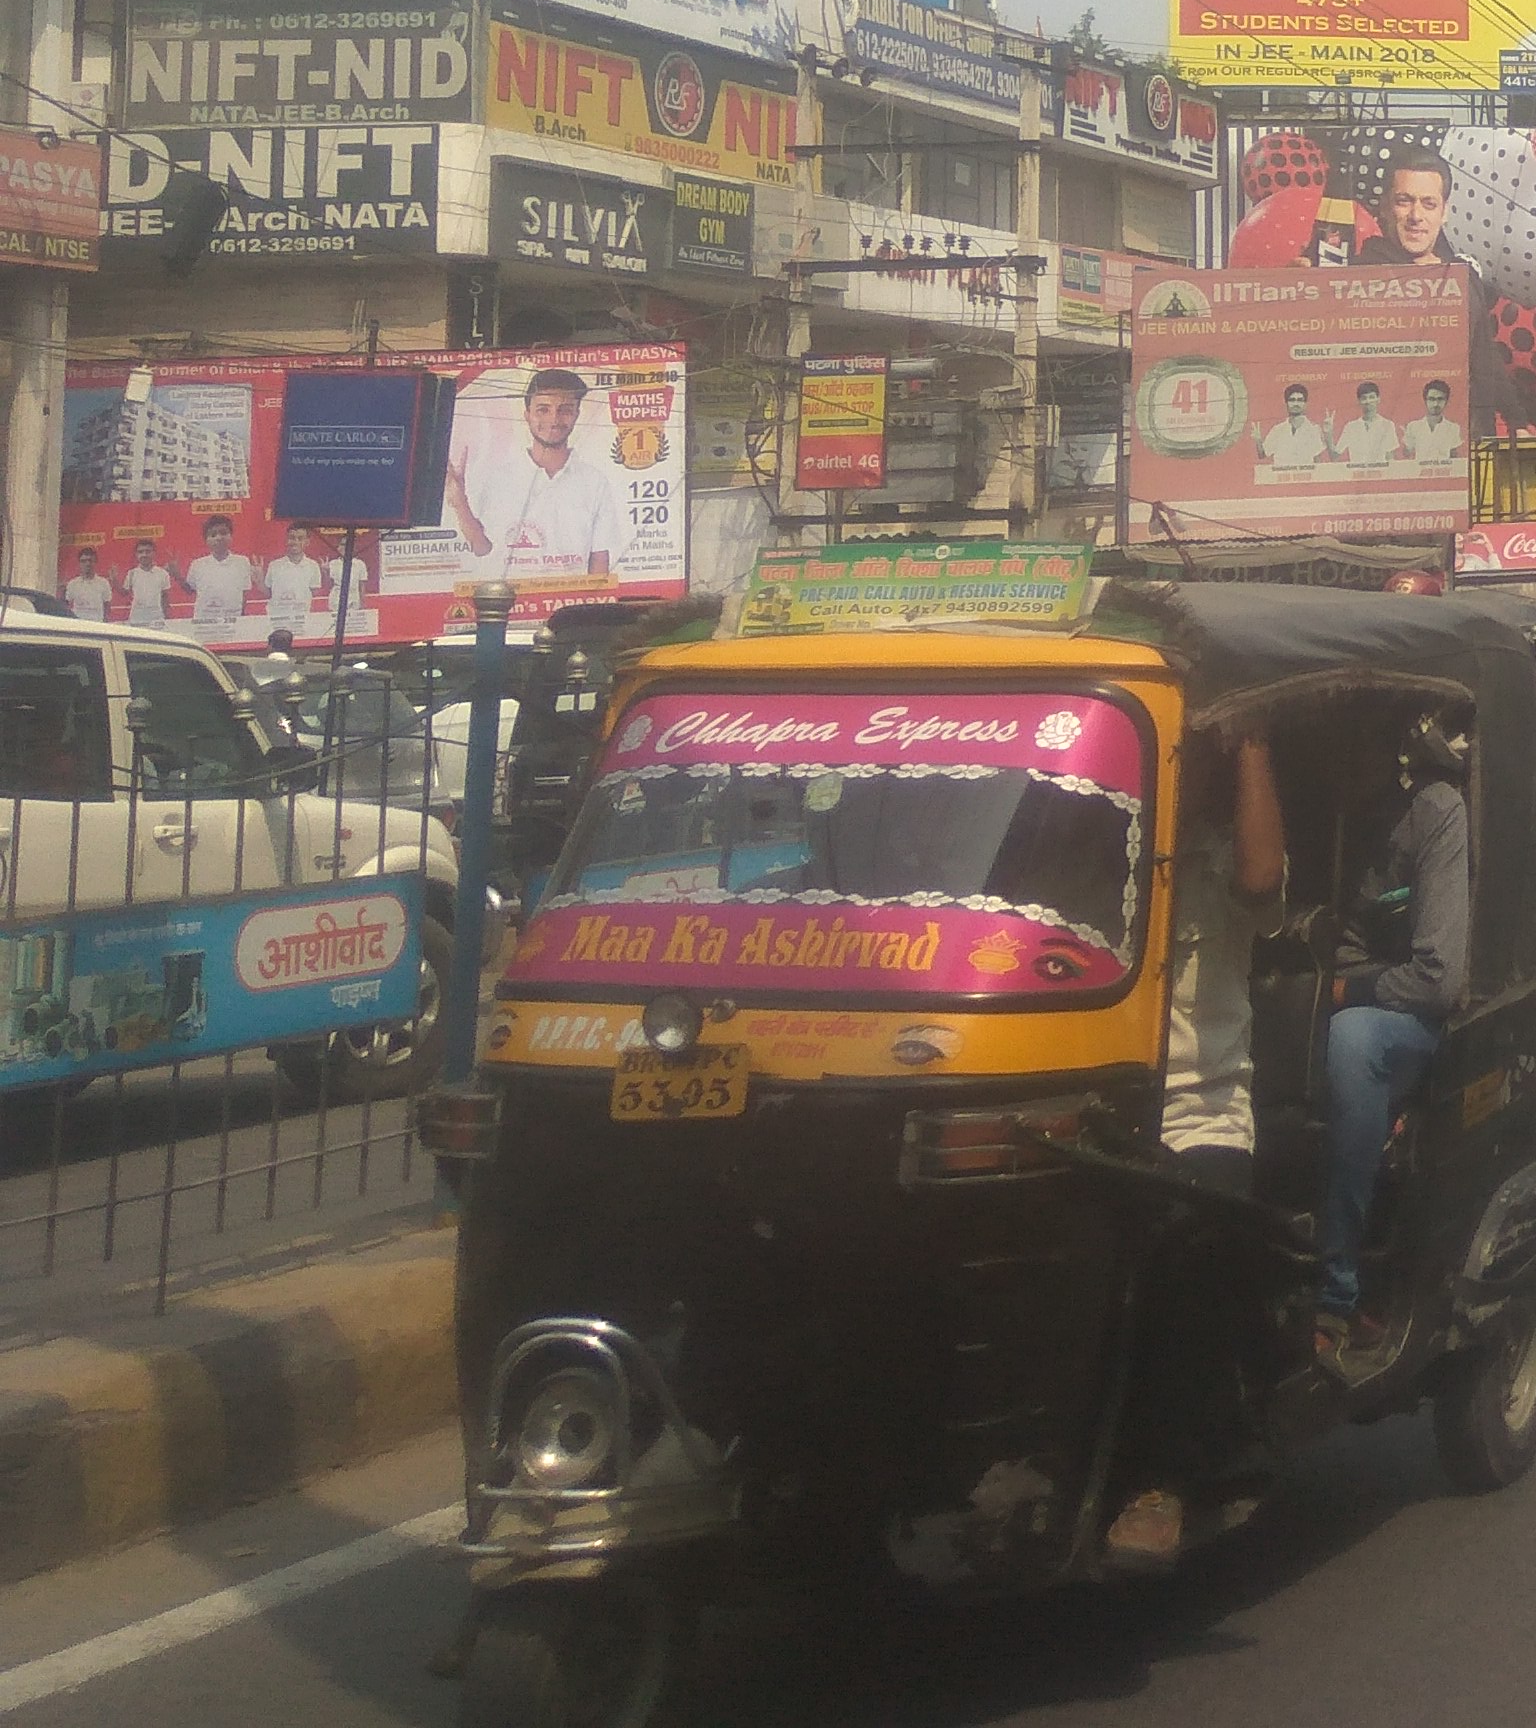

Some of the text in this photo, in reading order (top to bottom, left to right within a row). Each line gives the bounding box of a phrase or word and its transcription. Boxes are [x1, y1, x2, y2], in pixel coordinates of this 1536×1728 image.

[1216, 44, 1435, 63] IN JEE MAIN 2018
[130, 38, 467, 101] NIFT-NID
[497, 30, 634, 126] NIFT
[676, 182, 750, 217] DREAM BODY
[699, 217, 725, 245] GYM
[45, 239, 89, 259] NTSE
[1330, 277, 1462, 299] TAPASYA
[1138, 324, 1166, 335] JEE
[1339, 317, 1405, 329] MEDICAL
[1420, 316, 1458, 327] NTSE
[613, 346, 678, 360] TAPASYA
[1294, 347, 1330, 356] RESULT
[617, 393, 665, 406] MATHS
[1172, 380, 1208, 414] 41
[614, 406, 667, 420] TOPPER
[817, 454, 879, 469] airtel 4G
[628, 480, 669, 499] 120
[629, 506, 669, 525] 120
[386, 544, 450, 555] SHUBHAM
[1009, 584, 1067, 600] SERVICE
[811, 604, 841, 616] Call
[849, 603, 892, 615] Auto
[656, 708, 1019, 753] Chhapra Express
[561, 914, 941, 972] Maa Ka Ashirvad
